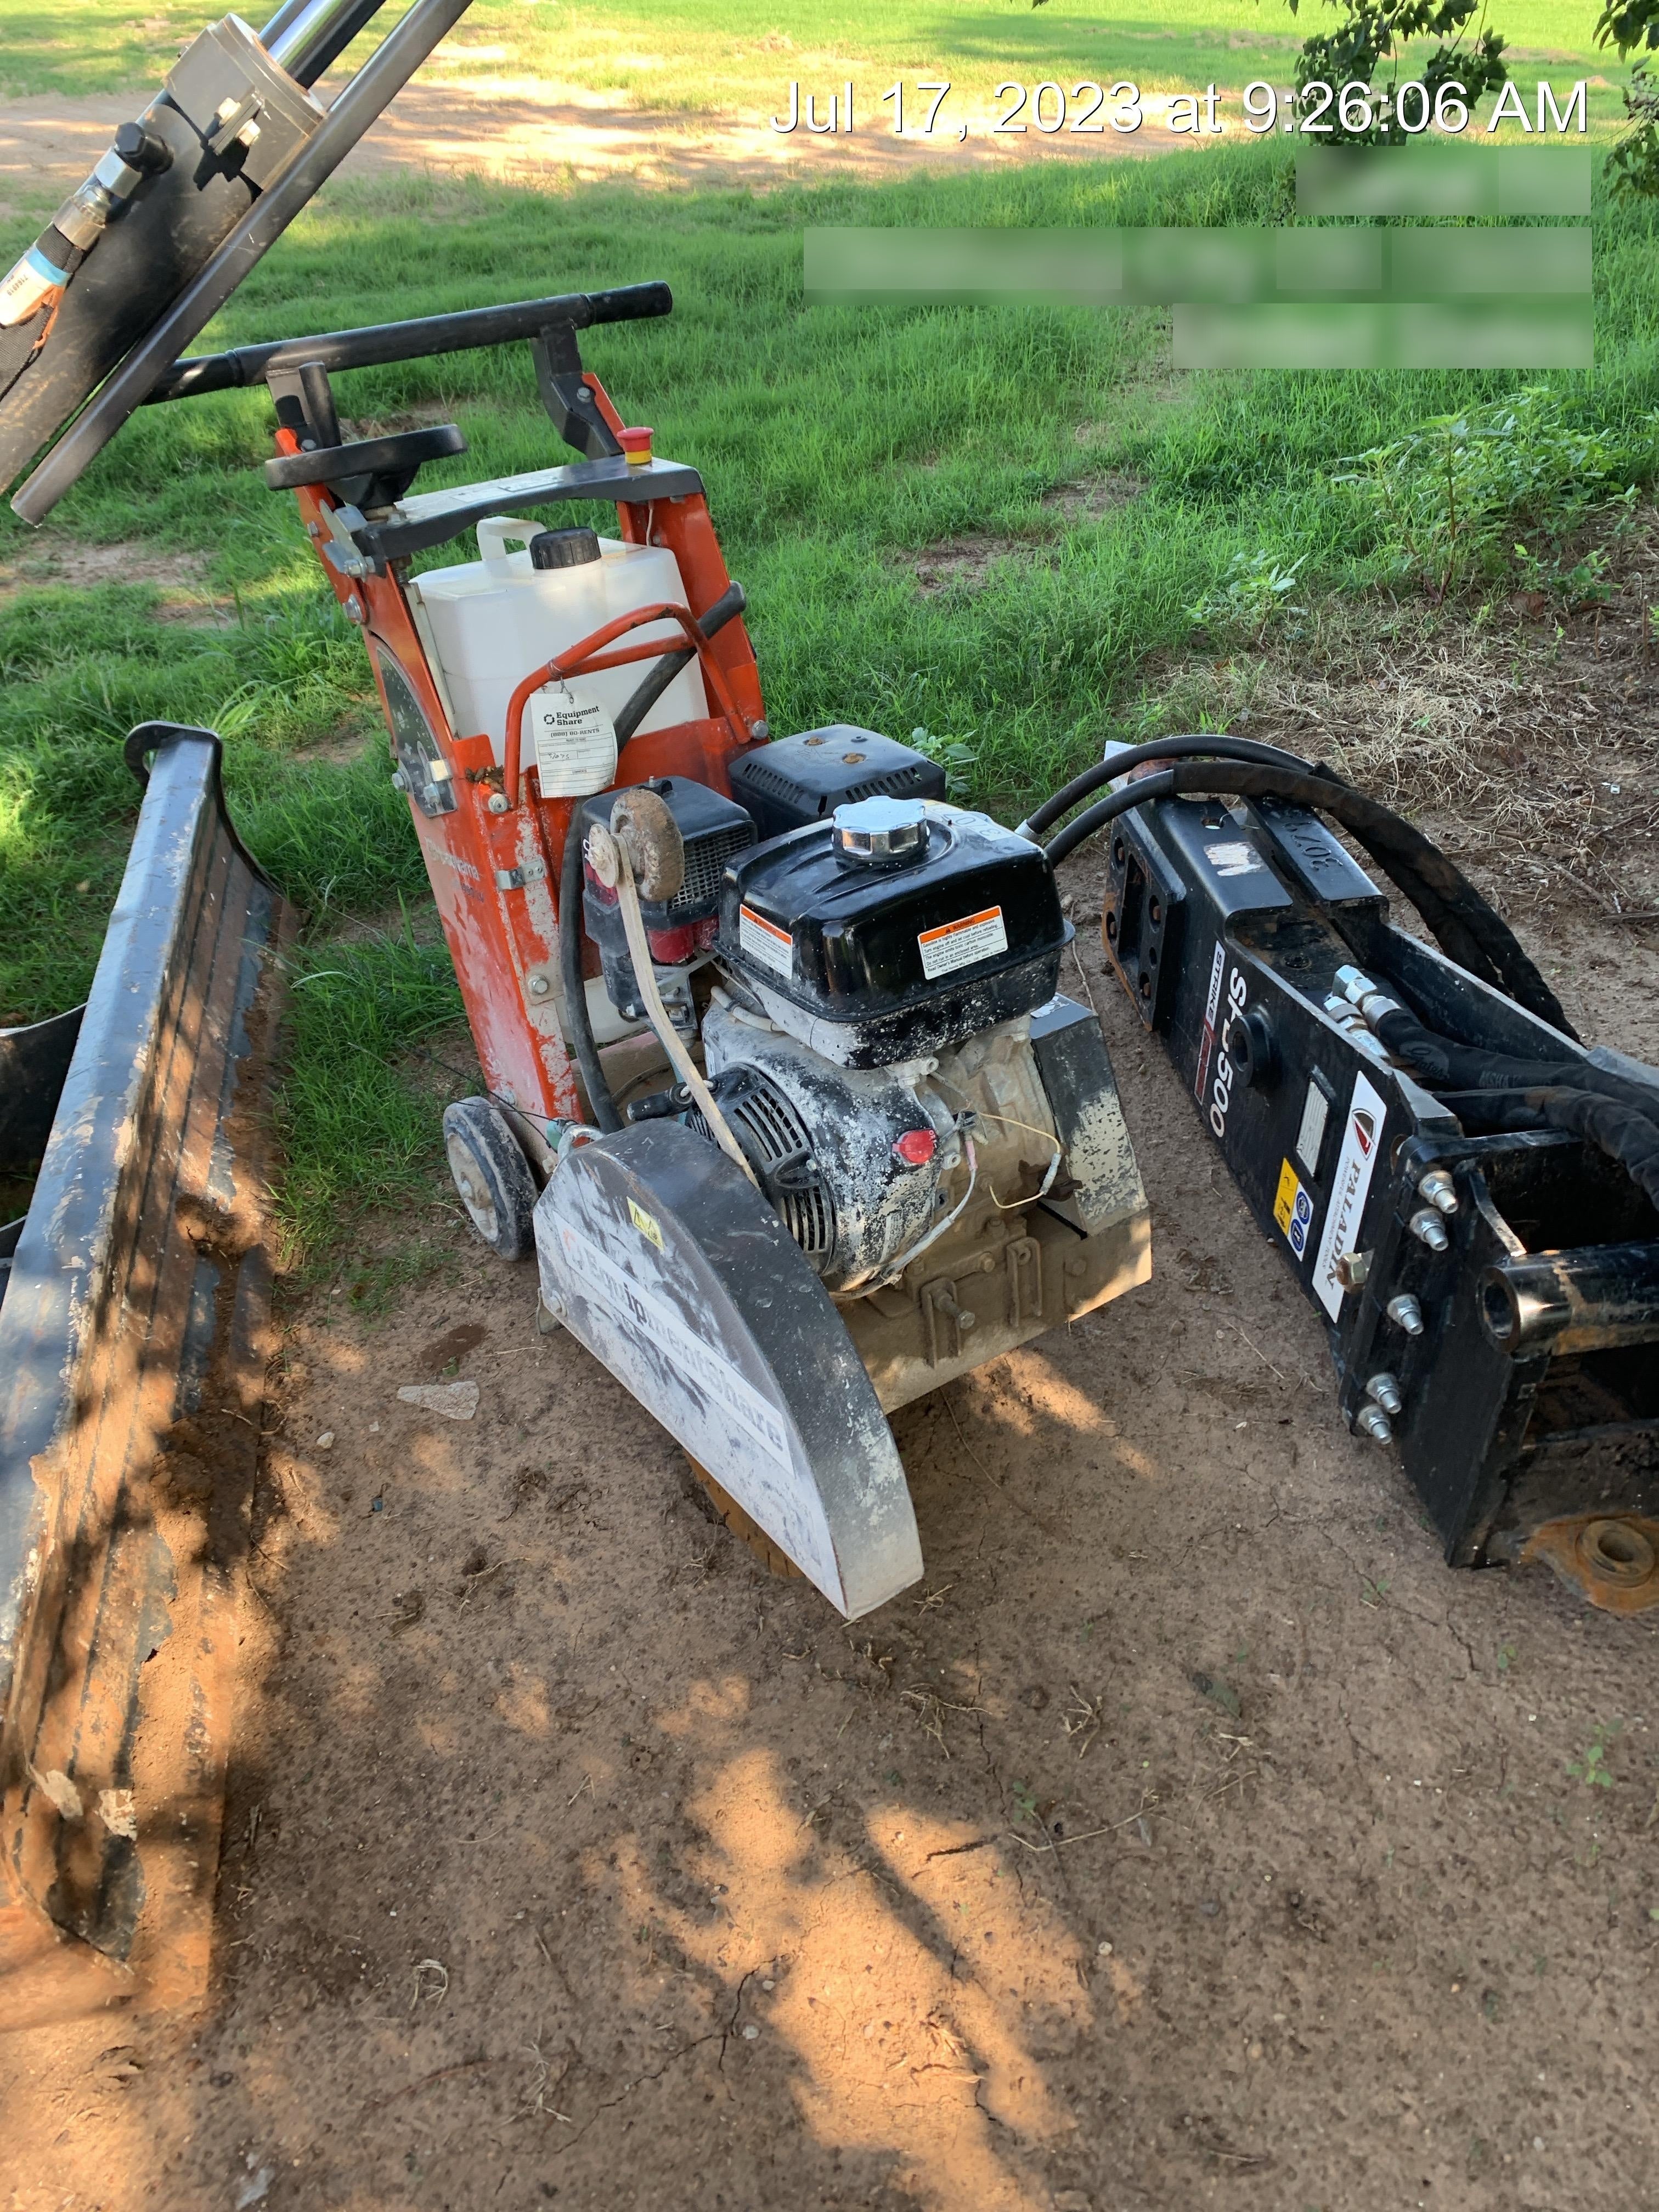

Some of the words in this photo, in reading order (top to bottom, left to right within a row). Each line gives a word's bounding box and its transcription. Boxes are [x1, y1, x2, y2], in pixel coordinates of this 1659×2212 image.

[556, 706, 600, 719] Equipment
[952, 918, 975, 930] WARNING
[954, 947, 969, 956] enclosed
[1208, 951, 1222, 1022] STRIKE
[1326, 1158, 1362, 1290] PALADIN
